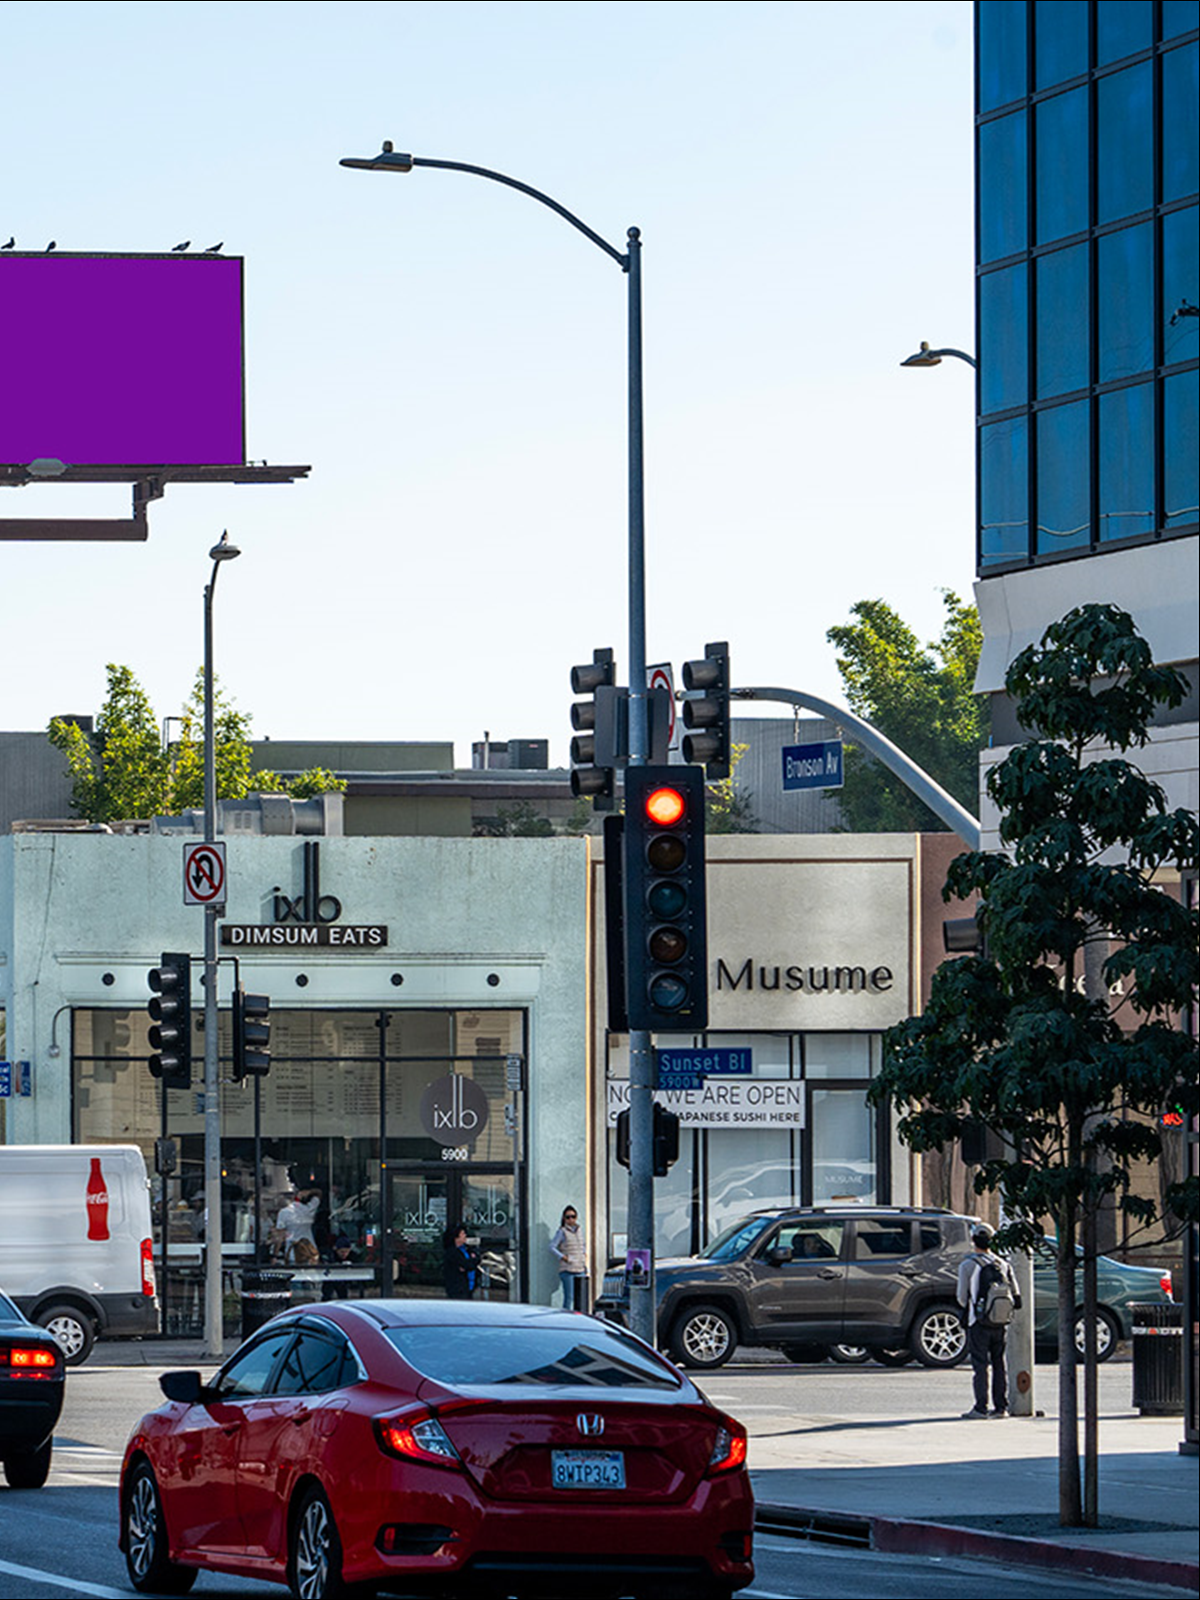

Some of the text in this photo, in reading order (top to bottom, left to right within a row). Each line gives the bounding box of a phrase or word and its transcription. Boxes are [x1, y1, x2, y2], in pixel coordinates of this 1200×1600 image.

[786, 751, 838, 778] Bronson Av
[231, 927, 382, 944] DIMSUM EATS
[717, 958, 893, 991] Musume
[661, 1054, 746, 1071] Sunset Bl
[660, 1076, 690, 1088] 5900
[666, 1088, 695, 1104] WE
[702, 1085, 740, 1105] ARE
[746, 1085, 800, 1105] OPEN
[676, 1111, 800, 1122] APANESE SUSHI HERE
[441, 1148, 469, 1161] 5900
[557, 1464, 620, 1483] 8WIP343
